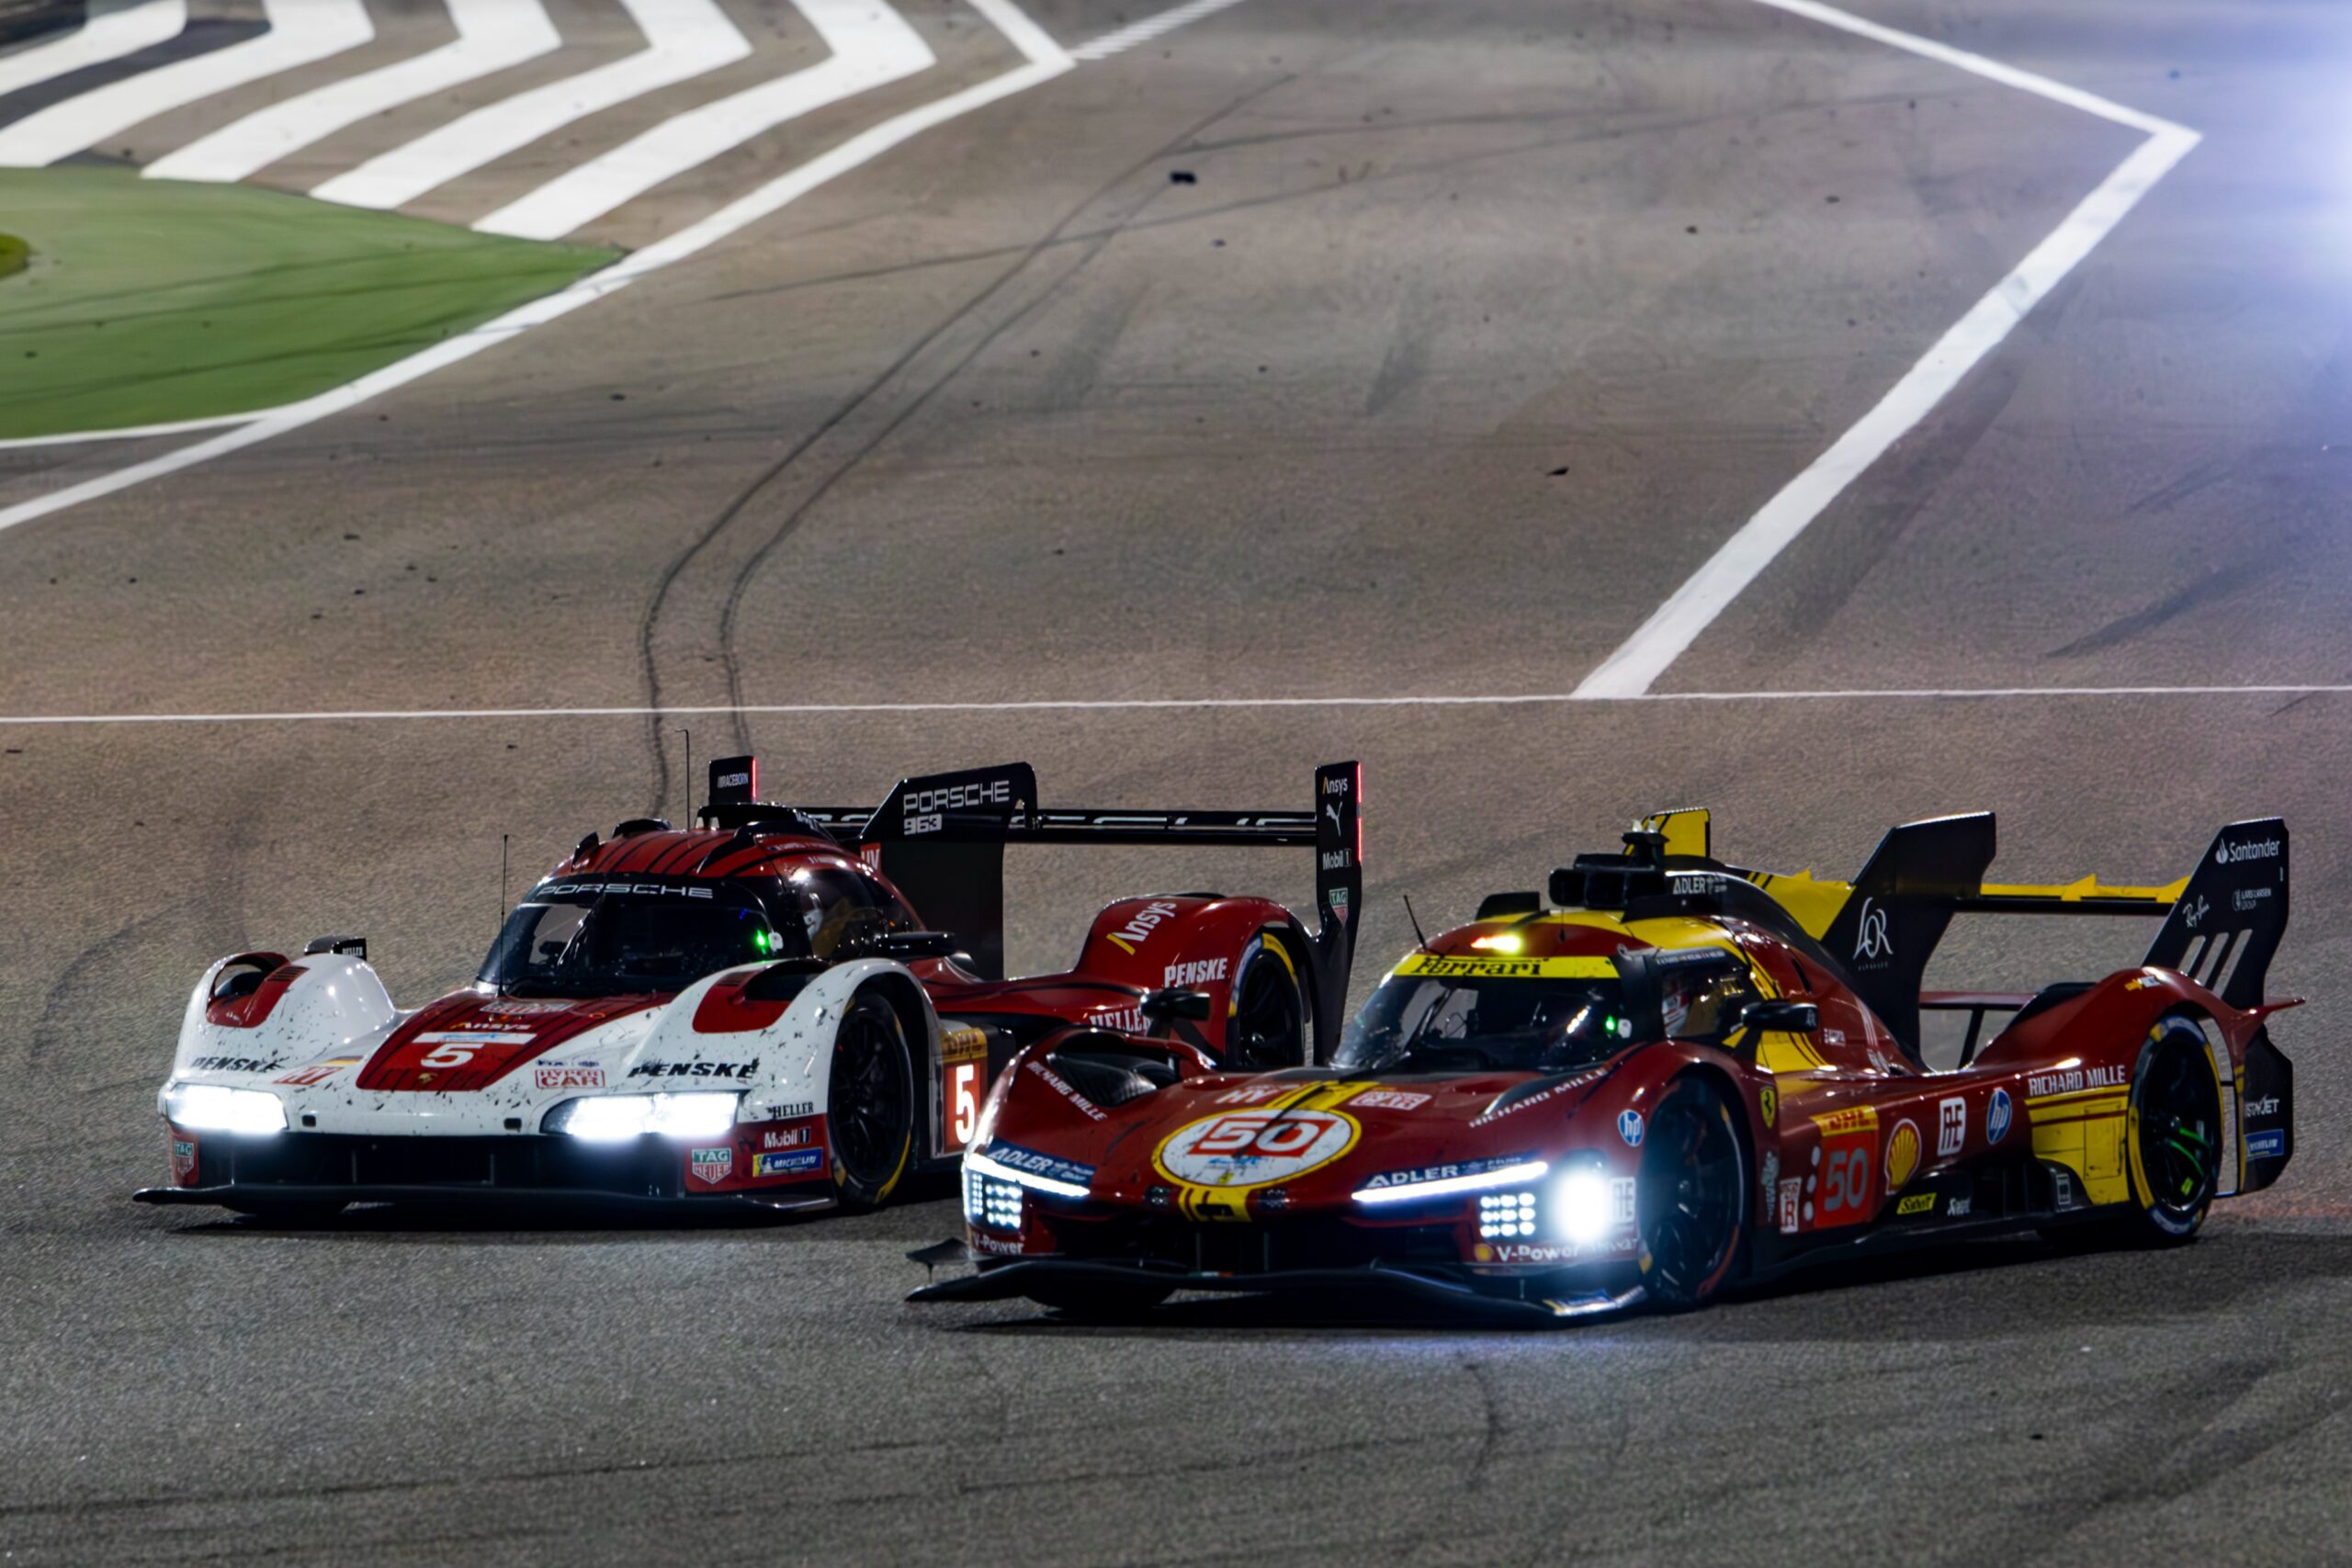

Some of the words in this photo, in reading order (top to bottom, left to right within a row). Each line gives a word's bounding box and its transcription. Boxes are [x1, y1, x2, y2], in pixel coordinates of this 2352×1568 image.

[903, 780, 1010, 816] PORSCHE
[1322, 776, 1349, 796] Ansys
[904, 814, 943, 835] 963
[1323, 851, 1343, 870] Mobil
[2229, 838, 2280, 863] Santander
[537, 884, 714, 898] PORSCHE
[1673, 876, 1706, 895] ADLER
[1332, 894, 1347, 905] TAG
[1106, 901, 1177, 956] Ansys
[1163, 957, 1228, 989] PENSKE
[1411, 957, 1550, 976] Ferrari
[420, 1043, 486, 1068] 5
[541, 1077, 599, 1087] CAR
[1026, 1061, 1074, 1096] RICHARD
[1069, 1093, 1108, 1122] MILLE
[2028, 1070, 2084, 1097] RICHARD
[2086, 1065, 2127, 1088] MILLE
[956, 1064, 975, 1145] 5
[1469, 1091, 1551, 1128] RICHARD
[1554, 1067, 1609, 1094] MILLE
[773, 1101, 815, 1119] HELLER
[1989, 1091, 2009, 1143] hp
[764, 1128, 797, 1149] Mobil
[1197, 1120, 1320, 1152] 50
[1624, 1111, 1643, 1145] hp
[175, 1144, 192, 1156] TAG
[695, 1150, 729, 1162] TAG
[987, 1147, 1054, 1171] ADLER
[694, 1164, 729, 1180] HEUER
[1366, 1165, 1458, 1189] ADLER
[1824, 1147, 1869, 1212] 50
[973, 1233, 1025, 1256] V-Power
